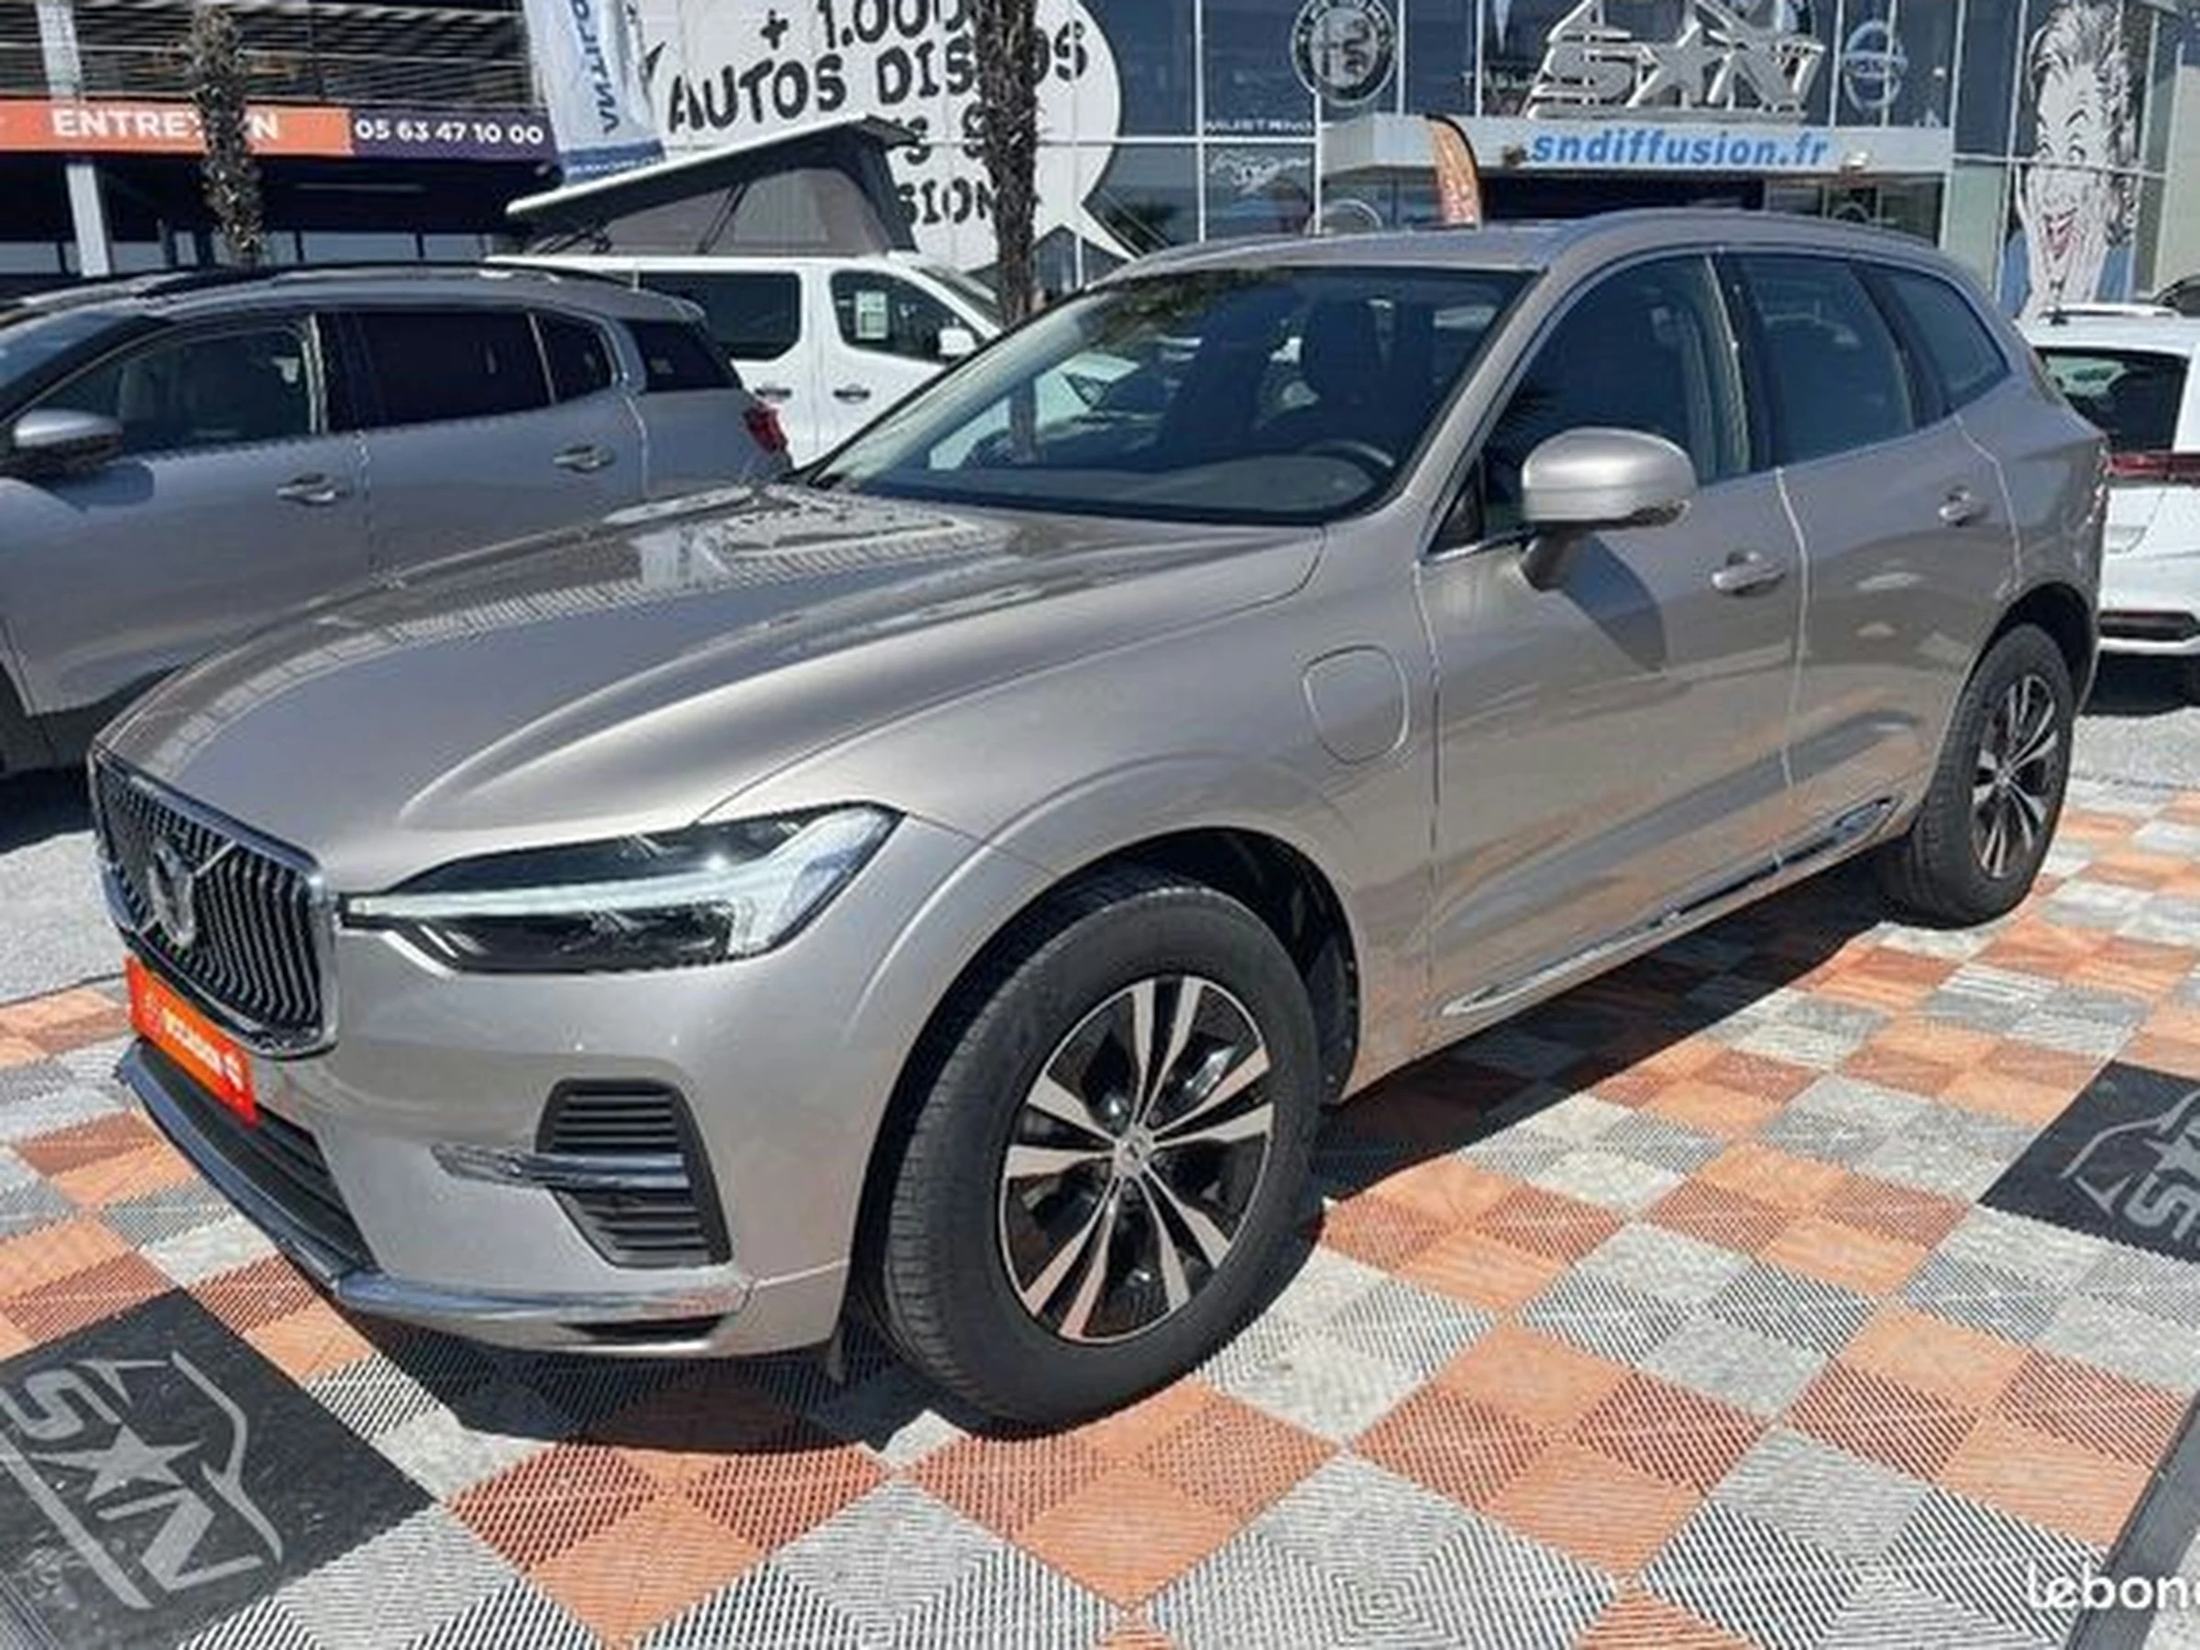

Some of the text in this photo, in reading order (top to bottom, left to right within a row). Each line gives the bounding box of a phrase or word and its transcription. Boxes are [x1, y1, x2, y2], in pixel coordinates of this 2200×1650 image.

[668, 20, 1089, 134] AUTOS DISOS
[355, 118, 545, 145] 05 63 47 10 00
[1531, 127, 1829, 166] sndiffusion.fr
